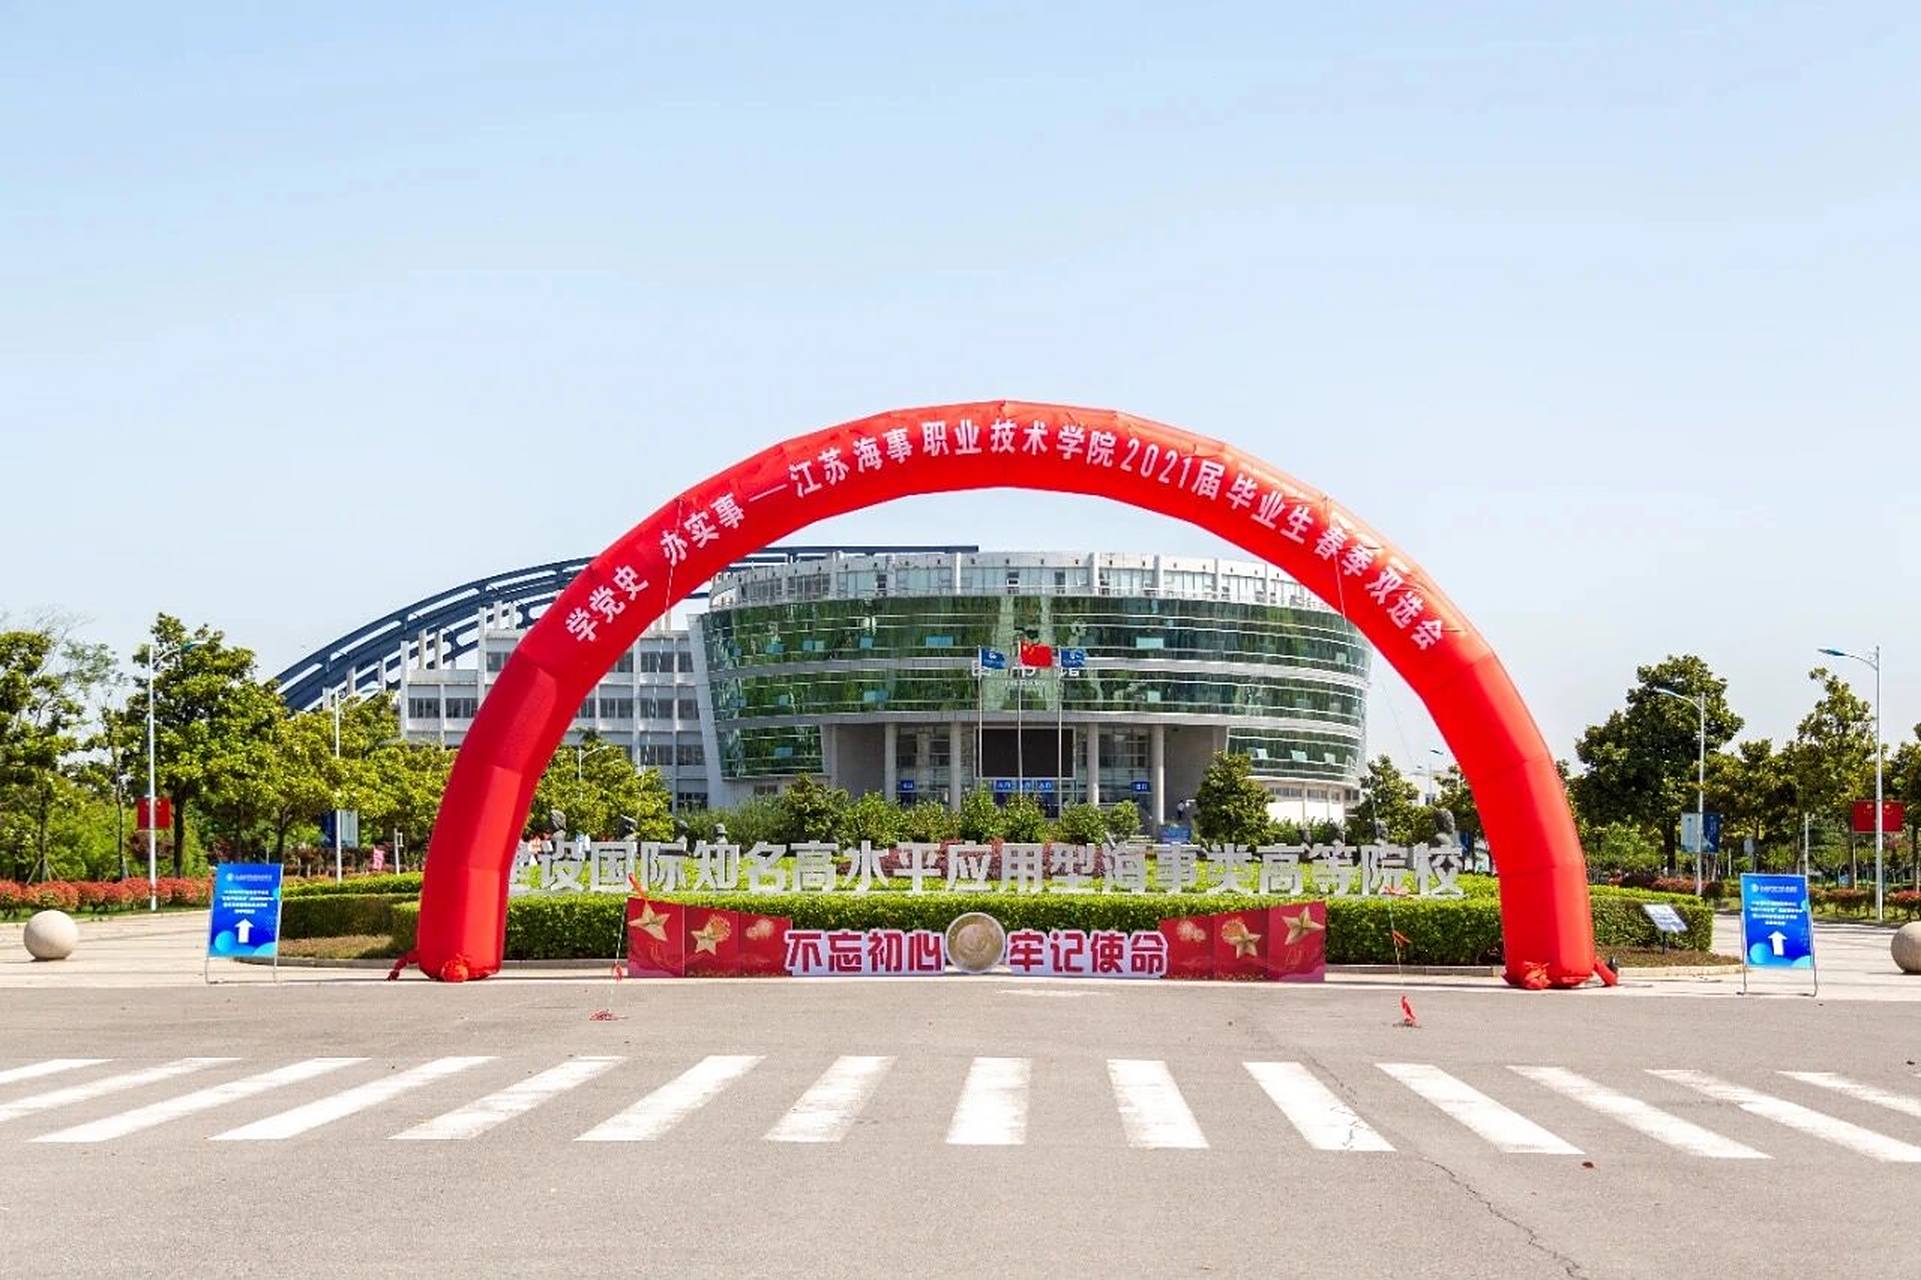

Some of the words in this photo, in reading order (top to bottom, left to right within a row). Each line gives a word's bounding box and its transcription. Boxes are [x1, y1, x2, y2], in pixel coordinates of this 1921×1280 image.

[565, 563, 650, 644] 学党史
[786, 930, 943, 974] 不忘初心
[1009, 930, 1166, 974] 牢记使命
